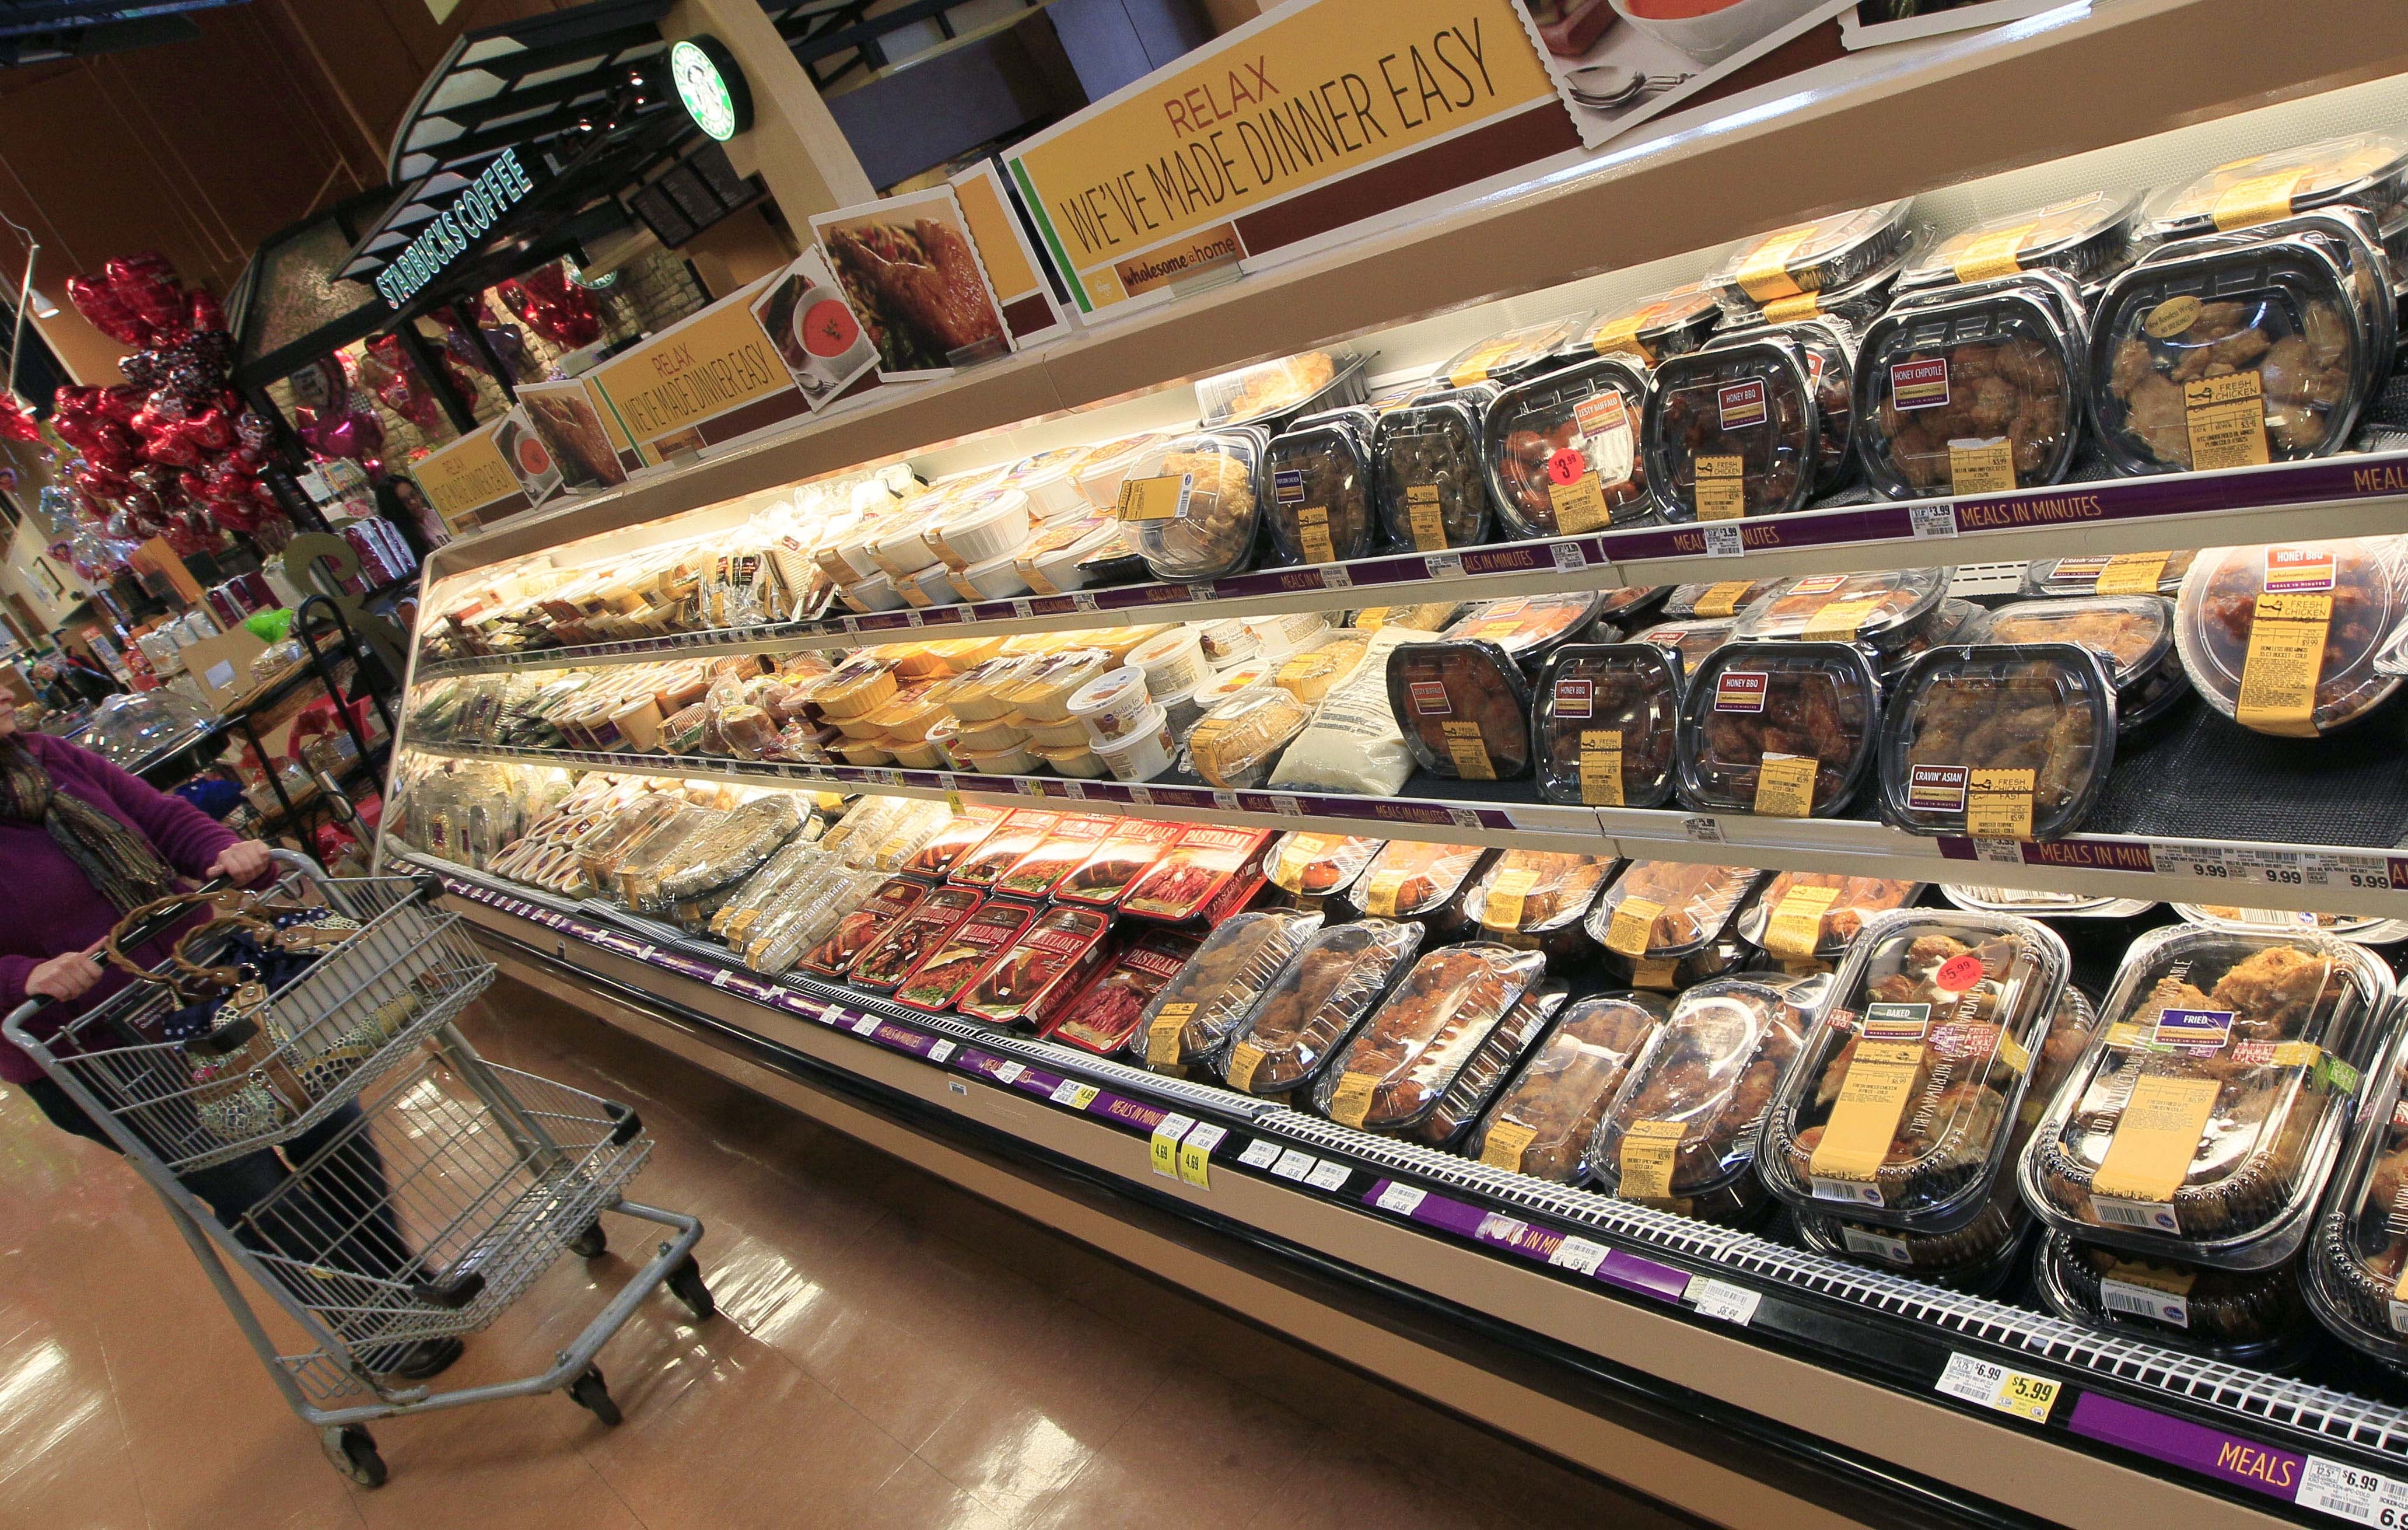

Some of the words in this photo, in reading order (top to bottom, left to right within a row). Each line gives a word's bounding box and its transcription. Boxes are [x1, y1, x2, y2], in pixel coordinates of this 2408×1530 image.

[1164, 55, 1280, 139] RELAX
[1059, 169, 1160, 255] WE'VE
[1146, 130, 1249, 222] MADE
[1237, 72, 1388, 184] DINNER
[1378, 16, 1496, 129] EASY
[376, 210, 468, 309] STARBUCKS
[454, 147, 533, 239] COFFEE
[1124, 235, 1236, 287] wholesome@home
[652, 343, 695, 379] RELAX
[1895, 371, 1913, 381] HONEY
[1915, 365, 1943, 379] CHIPOTLE
[621, 392, 666, 434] WE'VE
[652, 377, 697, 421] MADE
[684, 358, 743, 409] DINNER
[728, 341, 775, 390] EASY
[2216, 387, 2257, 401] CHICKEN
[2219, 379, 2252, 392] FRESH
[1726, 392, 1744, 403] HONEY
[1745, 389, 1756, 399] BBQ
[1578, 406, 1594, 418] ZESTY
[1594, 397, 1618, 411] BUFFALO
[2354, 466, 2408, 492] MEAL
[1929, 506, 1951, 517] $3.99
[1961, 504, 2010, 526] MEALS
[2011, 501, 2029, 522] IN
[2032, 495, 2101, 519] MINUTES
[1673, 530, 1706, 551] MEAL
[1742, 526, 1779, 546] NUTES
[1720, 526, 1737, 537] $3.99
[1481, 555, 1492, 569] IN
[1493, 550, 1534, 568] MINUTES
[2277, 550, 2305, 563] HONEY
[1281, 574, 1304, 588] MEALS
[2284, 607, 2327, 617] CHICKEN
[2290, 600, 2323, 609] FRESH
[1209, 628, 1226, 640] Sides
[1226, 626, 1237, 634] for
[1560, 686, 1574, 694] HONEY
[1576, 686, 1585, 694] BBQ
[1727, 679, 1745, 687] HONEY
[1746, 679, 1758, 687] BBQ
[1113, 701, 1131, 717] Sides
[1915, 771, 1941, 781] CRAVIN'
[1941, 773, 1962, 783] ASIAN
[1248, 797, 1272, 811] MEALS
[1376, 804, 1402, 819] MEALS
[1401, 807, 1412, 820] IN
[1412, 808, 1451, 824] MINUTES
[1177, 830, 1253, 851] PASTRAMI
[2039, 842, 2091, 864] MEALS
[2094, 844, 2112, 865] IN
[2193, 863, 2227, 878] 9.99
[2266, 869, 2302, 884] 9.99
[2350, 874, 2389, 889] 9.99
[991, 928, 1014, 944] PORK
[1125, 949, 1185, 976] PASTRAM
[1940, 961, 1971, 981] $5.99
[1886, 1008, 1910, 1017] BAKED
[2183, 1015, 2208, 1025] FRIED
[1109, 1099, 1133, 1118] MEALS
[1139, 1106, 1167, 1126] MINUT
[2088, 1117, 2113, 1137] LID
[1156, 1143, 1167, 1160] 4.69
[1185, 1153, 1199, 1171] 4.69
[1524, 1229, 1543, 1250] IN
[1975, 1363, 2001, 1381] $6.99
[2013, 1376, 2053, 1402] $5.99
[2217, 1442, 2297, 1489] MEALS
[2342, 1469, 2378, 1492] $6.99
